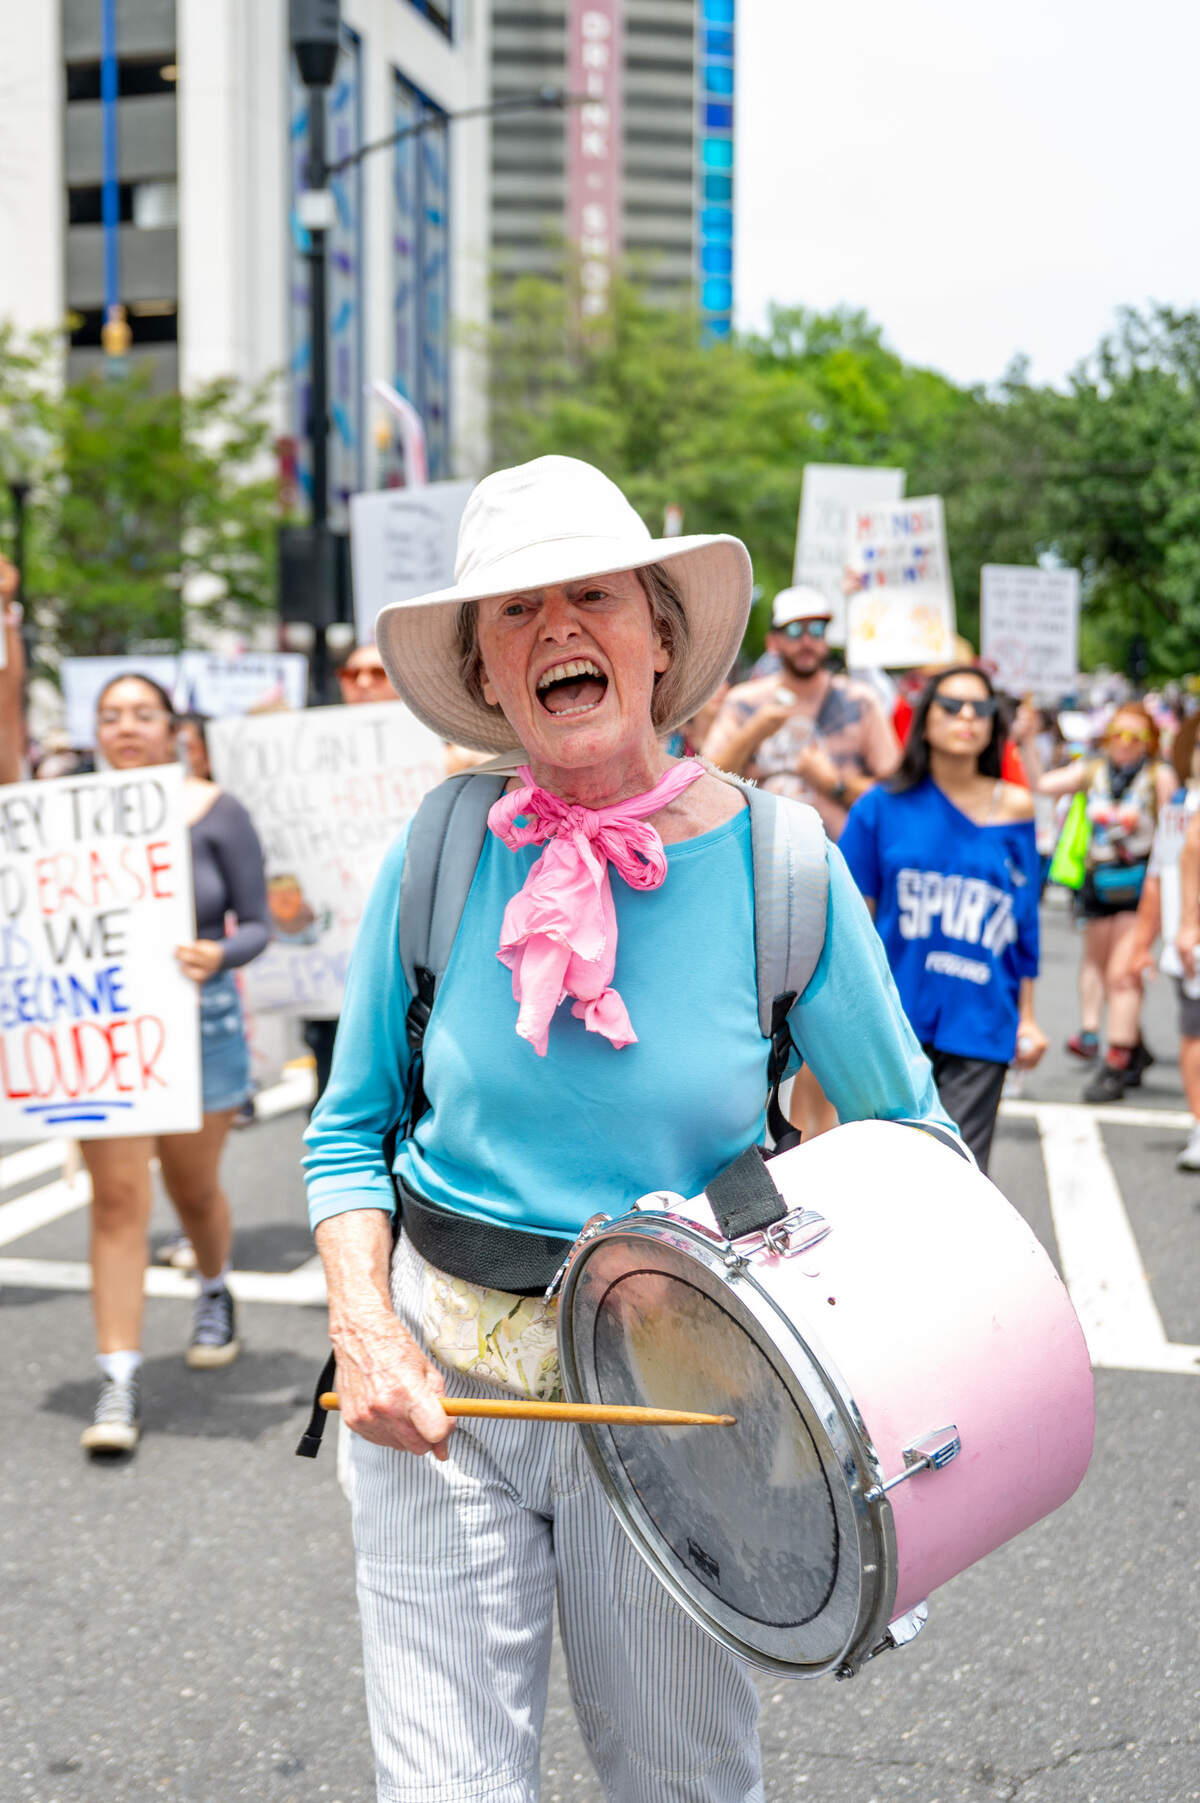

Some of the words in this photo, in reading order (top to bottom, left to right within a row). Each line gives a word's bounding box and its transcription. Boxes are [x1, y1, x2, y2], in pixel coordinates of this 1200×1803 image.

[62, 778, 167, 842] TRIED
[34, 841, 174, 914] ERASE
[45, 909, 130, 965] WE
[0, 1014, 167, 1100] LOUDER
